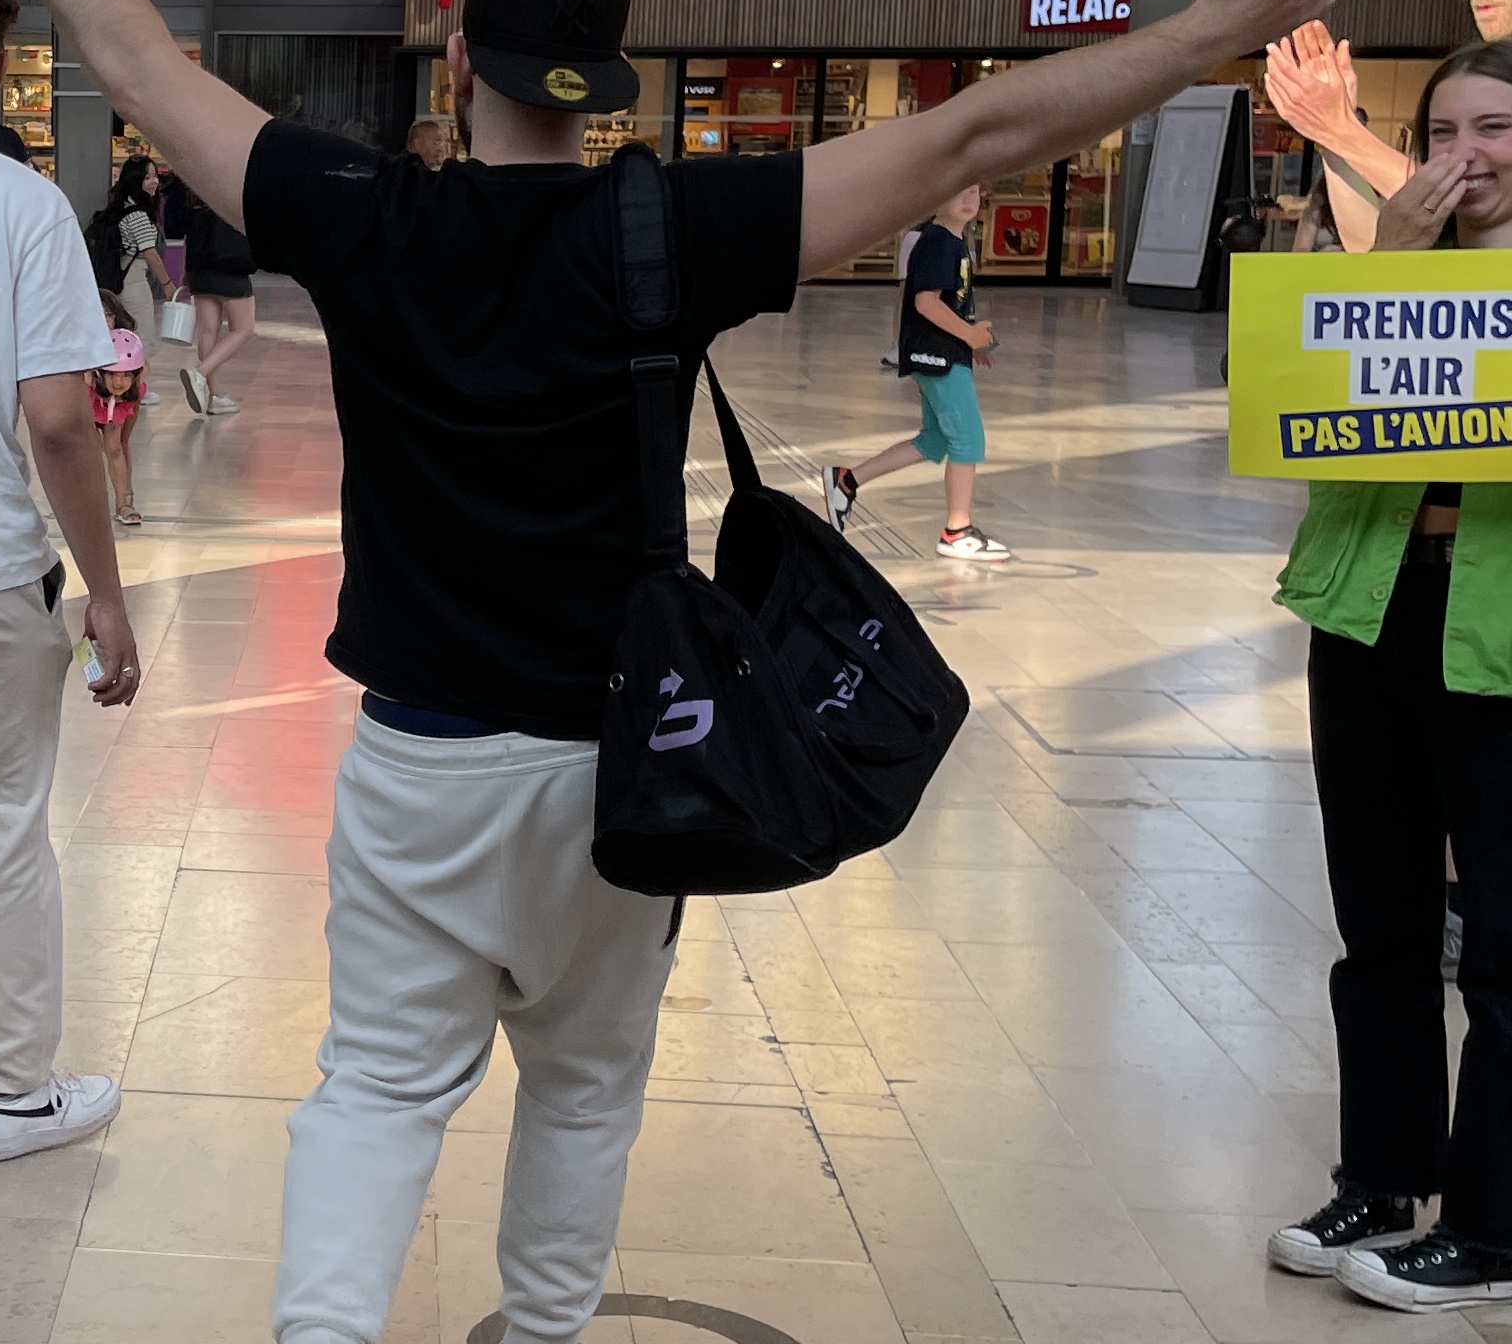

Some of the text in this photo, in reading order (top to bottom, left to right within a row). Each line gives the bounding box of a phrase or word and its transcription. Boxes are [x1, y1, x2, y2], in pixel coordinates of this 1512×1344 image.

[1313, 298, 1512, 341] PRENONS
[1360, 356, 1464, 396] L'AIR
[1289, 406, 1512, 453] PAS L'AVION
